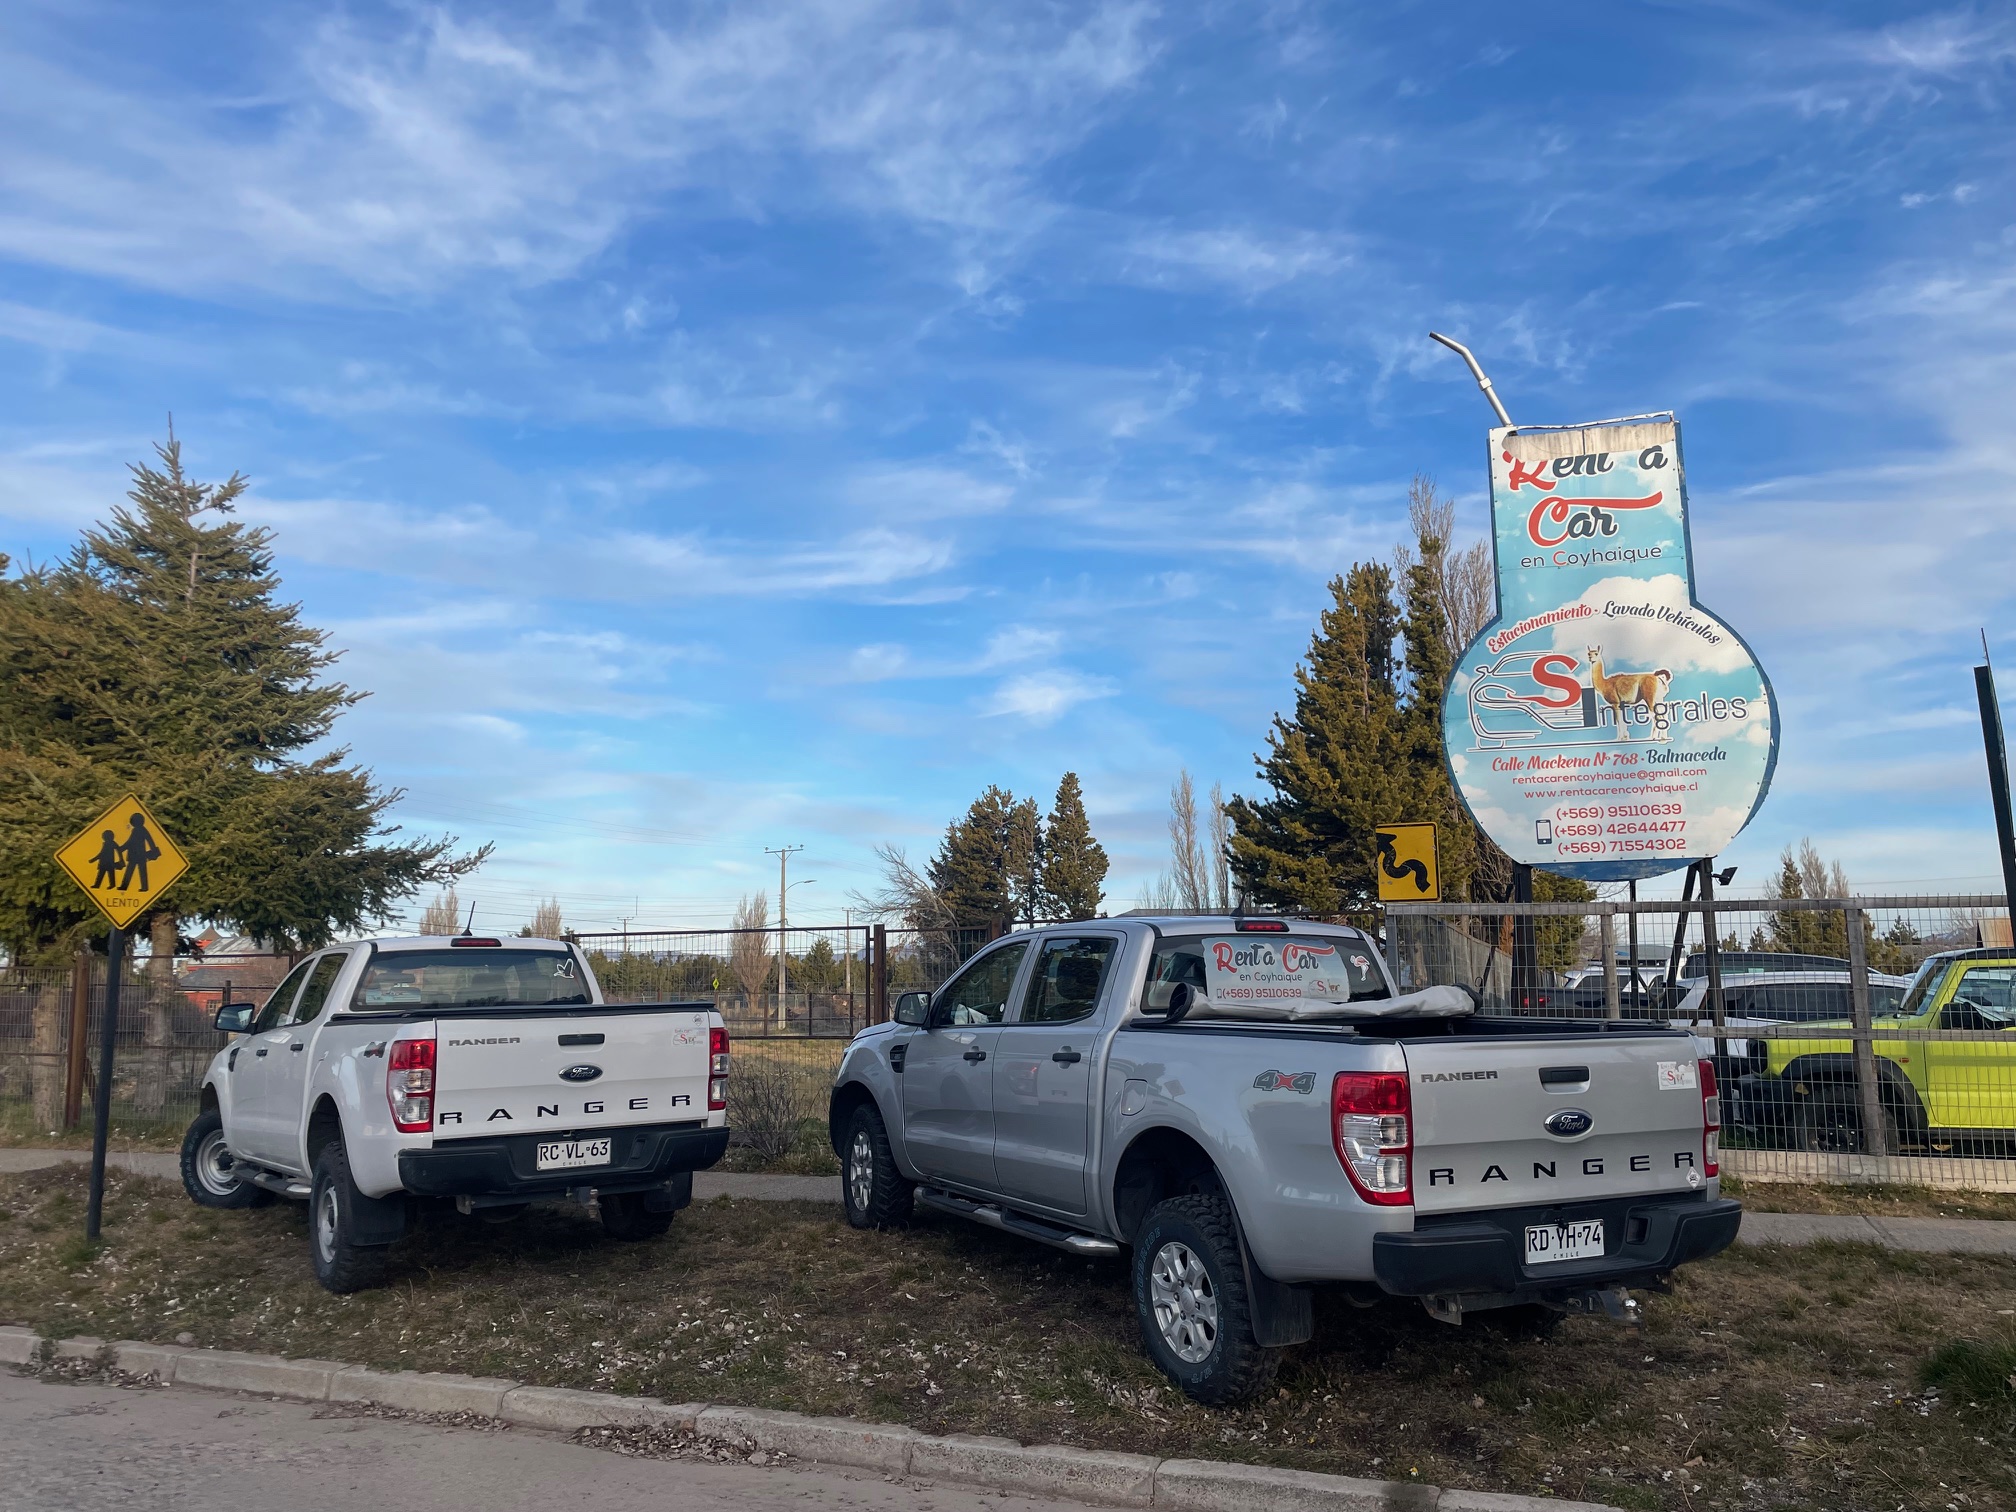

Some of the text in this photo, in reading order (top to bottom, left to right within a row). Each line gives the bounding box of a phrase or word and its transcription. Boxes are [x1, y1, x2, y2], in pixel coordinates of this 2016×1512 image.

[1638, 445, 1668, 470] a
[1528, 491, 1663, 547] Car
[1521, 547, 1662, 568] en Coyhaique
[1488, 600, 1722, 653] Estacionamiento Lavado Vehículos
[1492, 756, 1524, 772] Calle
[1527, 752, 1590, 770] Mackena
[1612, 752, 1638, 767] 768
[1646, 746, 1727, 764] Balmaceda
[1512, 767, 1707, 785] rentacarencoyhaique@gmail.com
[1524, 782, 1698, 799] www.rentacarencoyhaique.cl
[1556, 803, 1682, 820] (+569) 95110639
[1554, 820, 1686, 838] (+569) 42644477
[1558, 838, 1686, 856] (+569) 71554302
[106, 898, 140, 908] LENTO
[1212, 942, 1335, 973] Rent a Car
[1254, 971, 1302, 983] Coyhaique
[1222, 987, 1302, 999] (+569) 95110639
[448, 1036, 521, 1047] RANGER
[1421, 1070, 1498, 1083] RANGER
[439, 1094, 691, 1126] RANGER
[1559, 1115, 1585, 1131] Ford
[1429, 1151, 1694, 1186] RANGER
